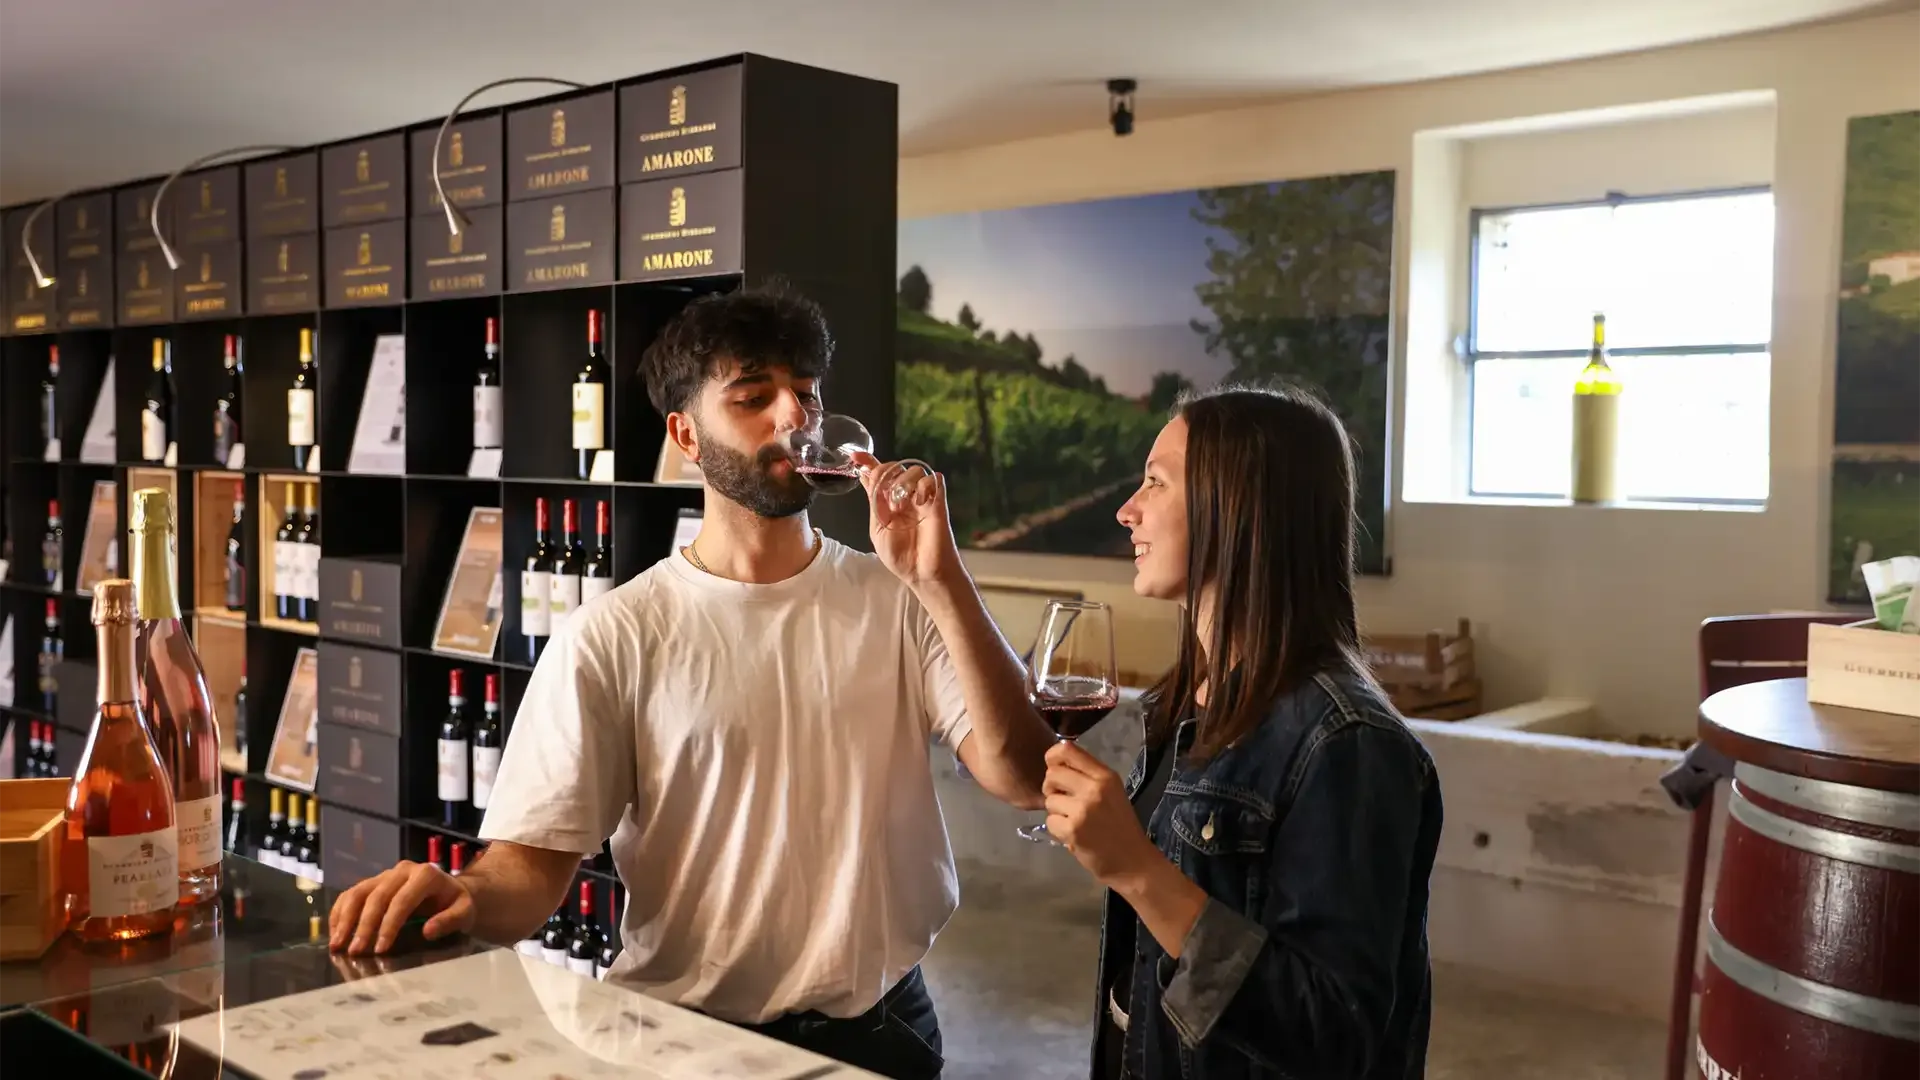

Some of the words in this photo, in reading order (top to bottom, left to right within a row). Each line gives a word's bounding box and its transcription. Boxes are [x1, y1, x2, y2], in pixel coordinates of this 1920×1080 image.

[641, 145, 714, 172] AMARONE
[527, 166, 590, 189] AMARONE
[642, 248, 714, 271] AMARONE
[525, 262, 589, 284] AMARONE
